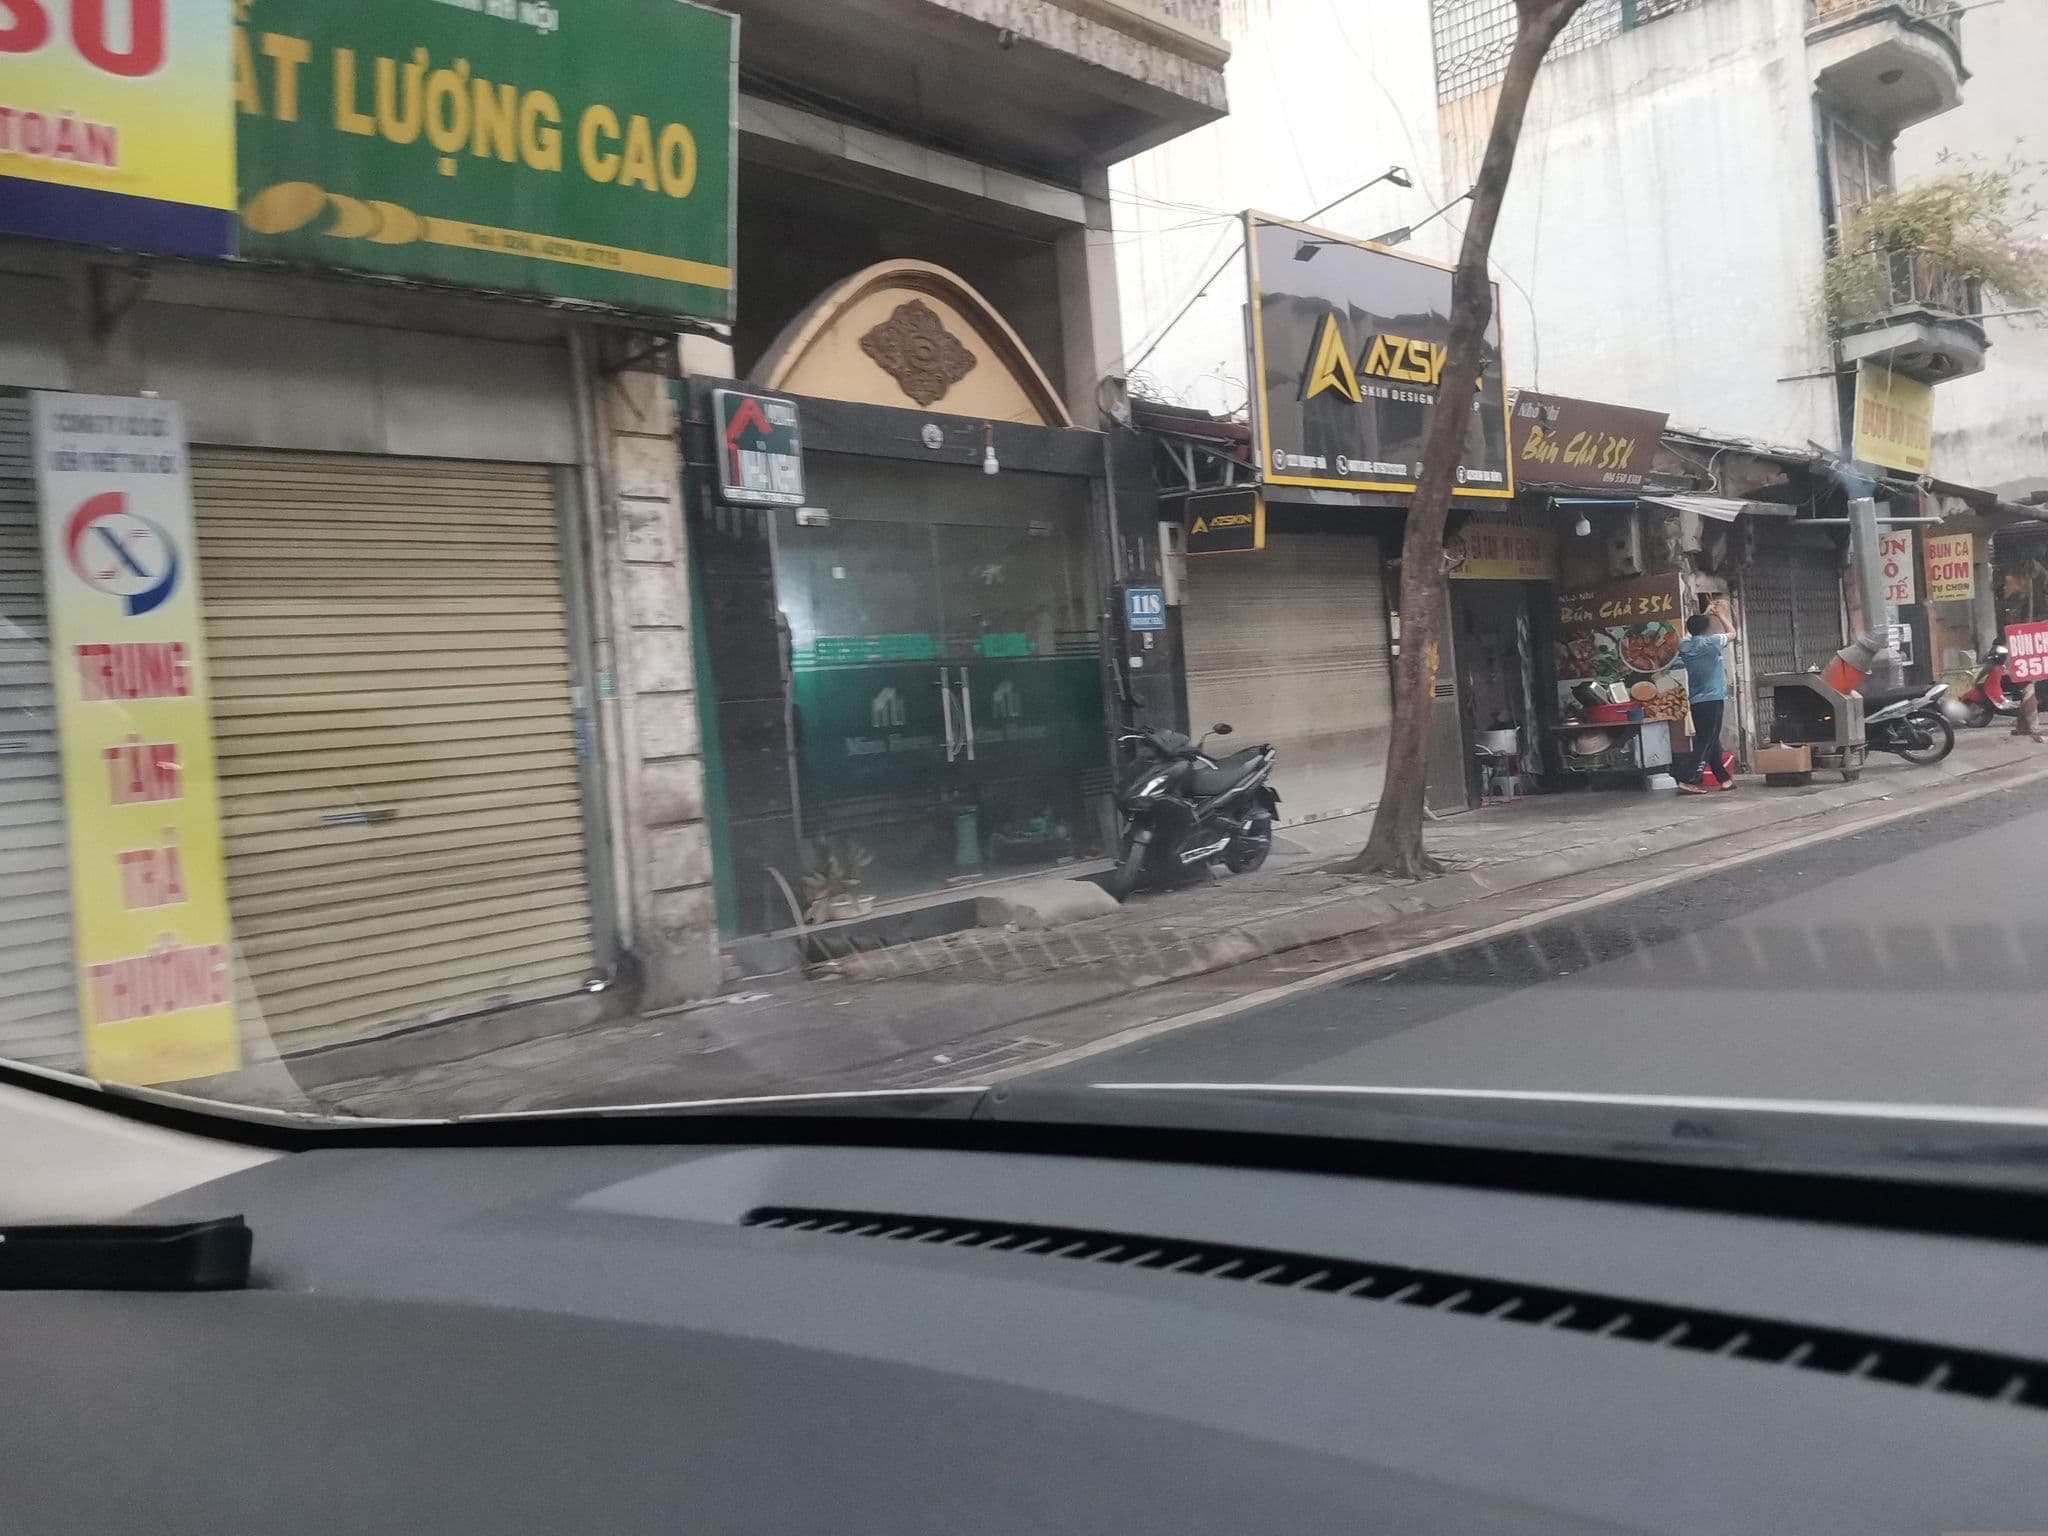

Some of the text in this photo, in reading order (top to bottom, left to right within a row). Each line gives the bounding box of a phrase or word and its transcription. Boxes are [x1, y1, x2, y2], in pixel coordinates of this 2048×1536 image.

[332, 47, 563, 177] LƯỢNG
[578, 104, 698, 199] CAO
[1361, 384, 1388, 399] SKIN
[1391, 390, 1434, 406] DESIGN
[74, 637, 190, 700] TRUNG
